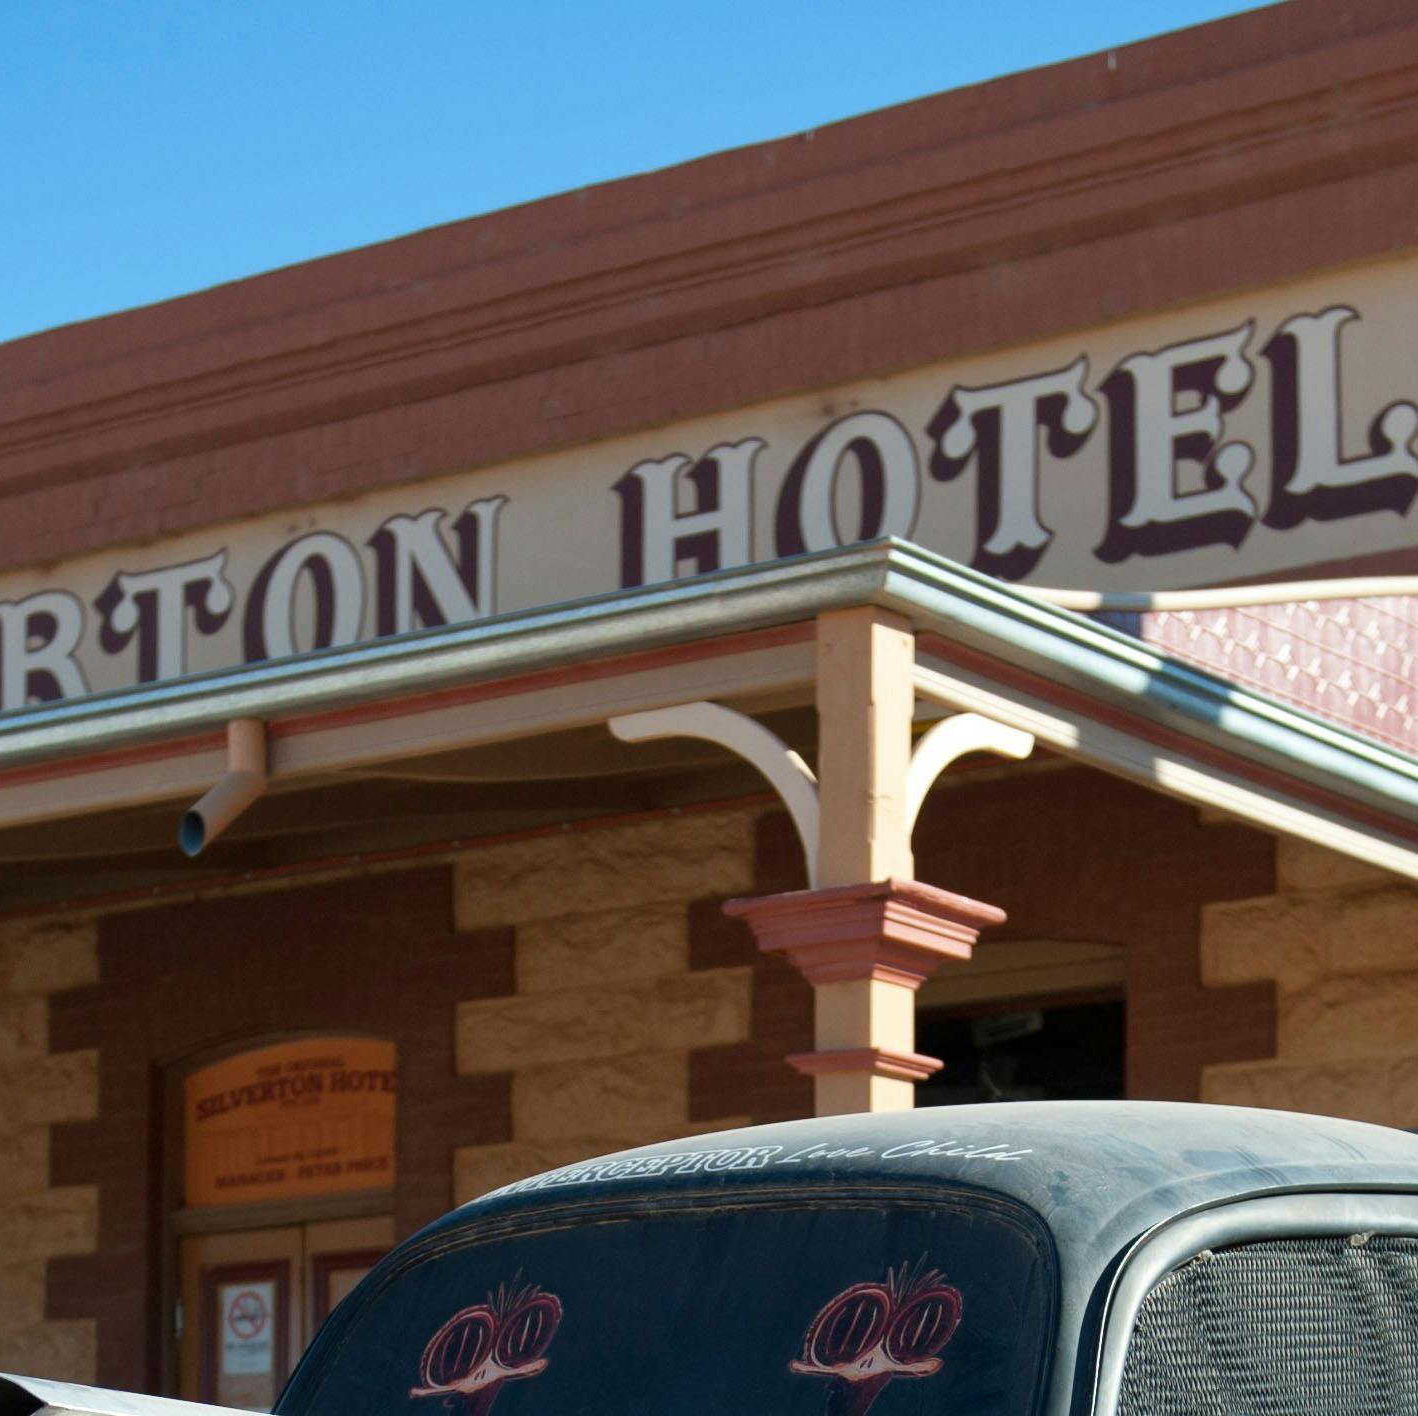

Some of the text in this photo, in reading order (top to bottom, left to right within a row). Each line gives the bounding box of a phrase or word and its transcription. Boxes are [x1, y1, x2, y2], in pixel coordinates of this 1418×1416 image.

[194, 1072, 324, 1122] SILVERTON
[331, 1069, 396, 1093] HOTE
[776, 1142, 877, 1164] Love
[881, 1140, 1033, 1161] Child
